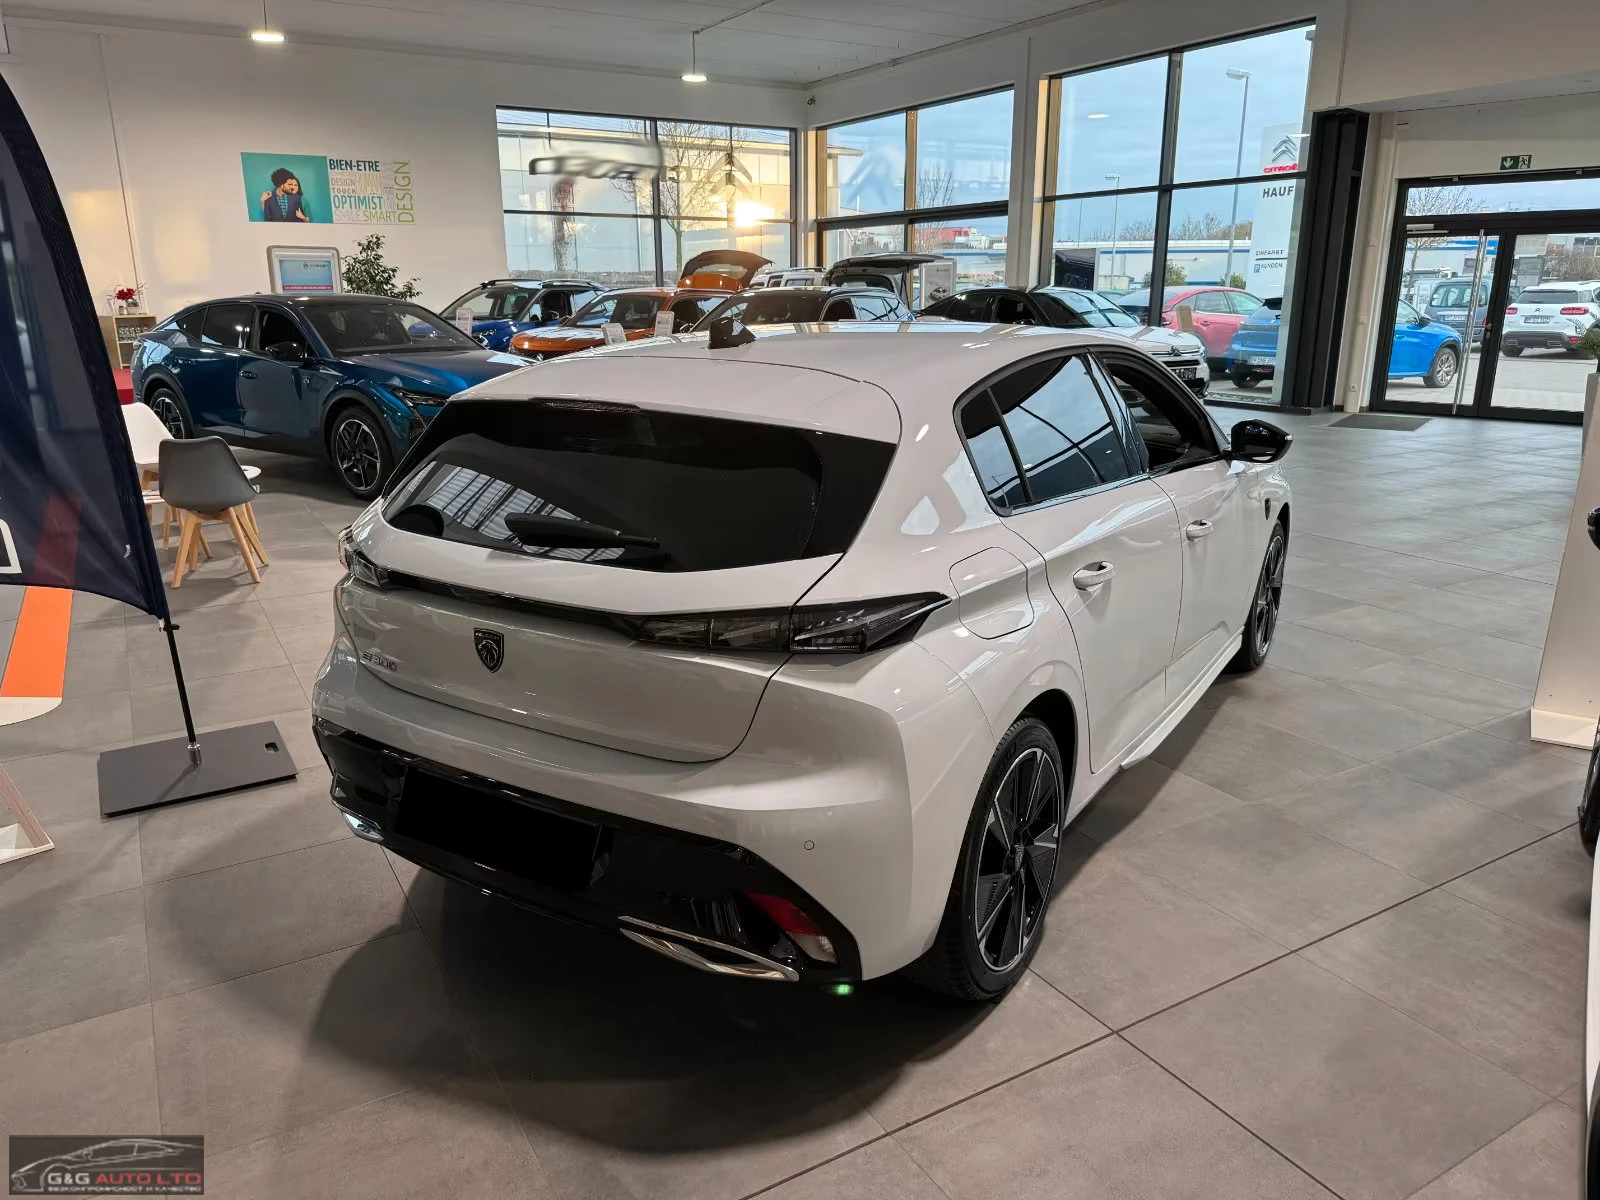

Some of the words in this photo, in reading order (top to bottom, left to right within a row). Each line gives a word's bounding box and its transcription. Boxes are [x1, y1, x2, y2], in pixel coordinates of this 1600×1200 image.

[329, 159, 380, 172] BIEN-ETRE
[1264, 164, 1298, 173] CITROË
[332, 187, 356, 195] TOUCH
[393, 162, 414, 223] DESIGN
[1262, 185, 1295, 198] HAUF
[333, 195, 383, 210] OPTIMIST
[363, 210, 397, 222] SMART
